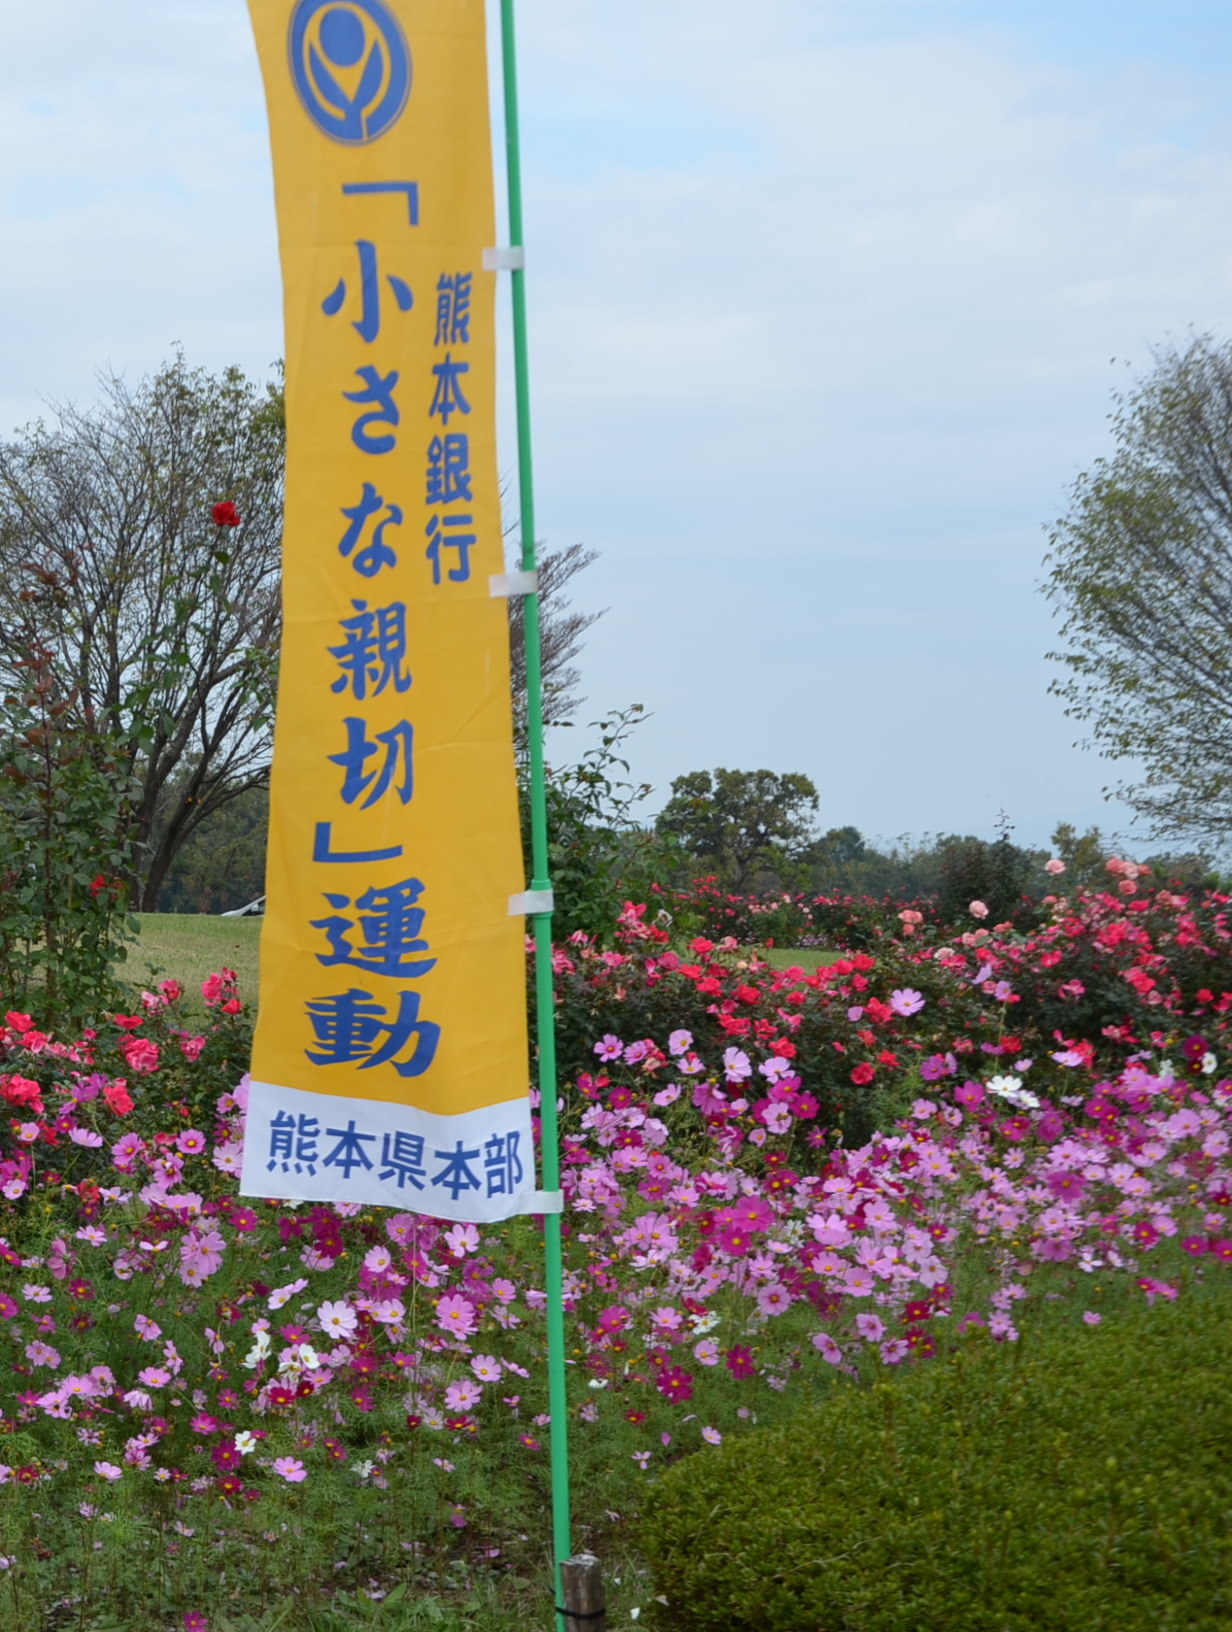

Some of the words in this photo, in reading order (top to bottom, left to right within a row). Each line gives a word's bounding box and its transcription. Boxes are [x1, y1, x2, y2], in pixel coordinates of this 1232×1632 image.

[424, 272, 477, 586] 熊本銀行
[303, 180, 442, 1078] 「小さな親切」運動
[265, 1109, 524, 1201] 熊本県本部
